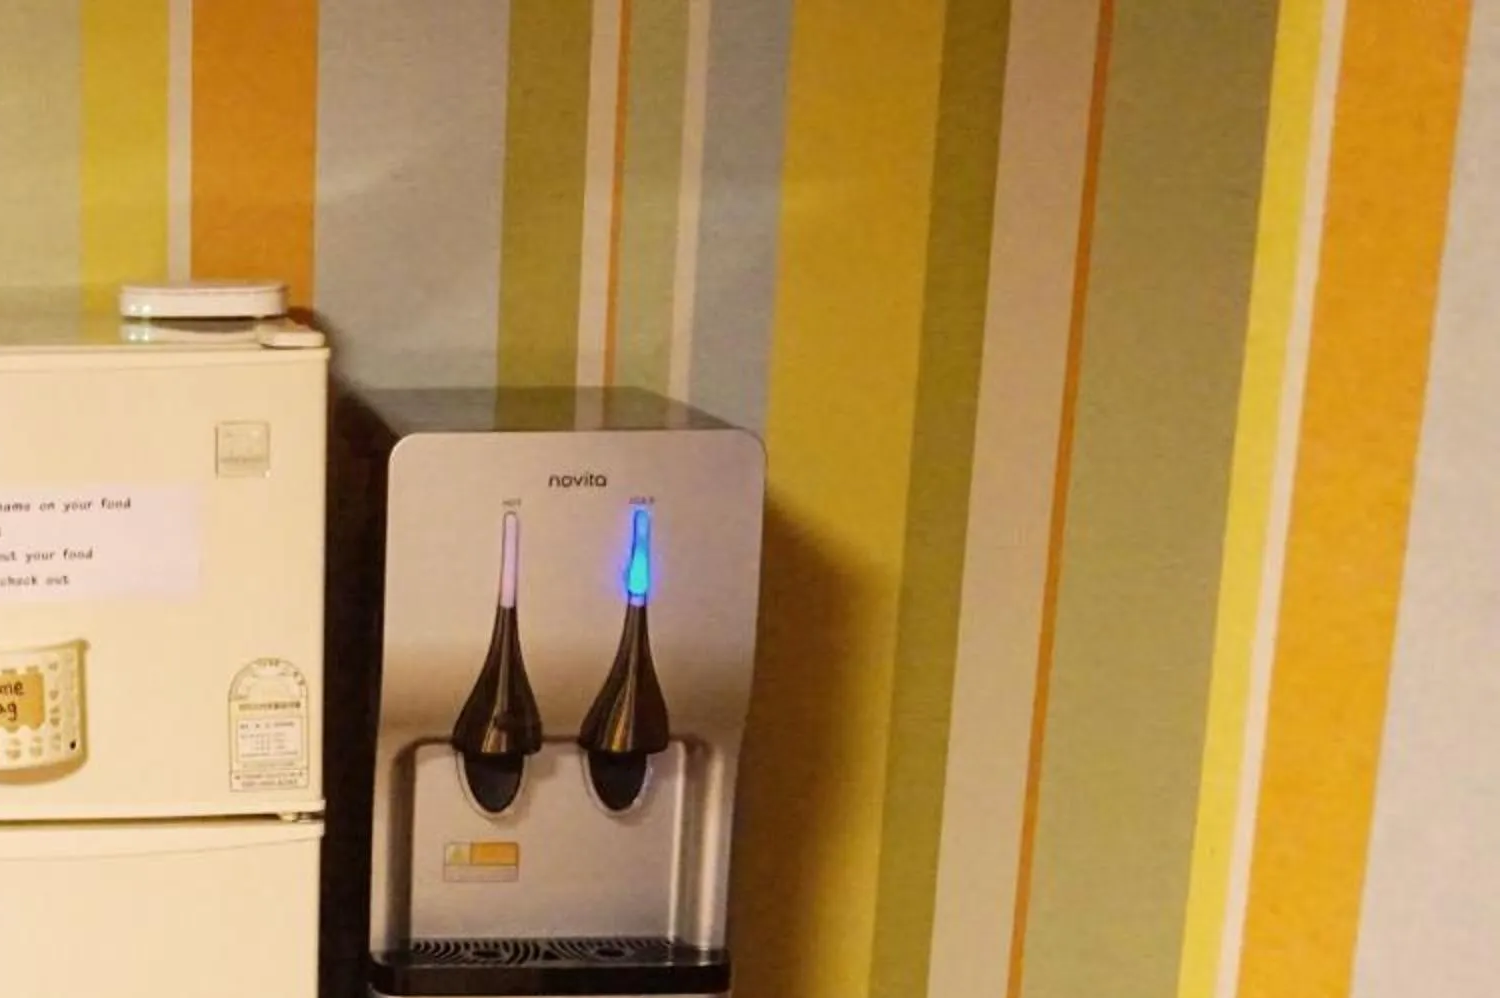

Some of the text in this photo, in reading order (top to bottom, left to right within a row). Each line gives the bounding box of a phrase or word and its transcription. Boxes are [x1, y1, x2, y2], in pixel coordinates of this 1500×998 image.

[548, 473, 608, 488] novita
[38, 501, 56, 512] on
[62, 500, 93, 514] your
[100, 497, 132, 511] food
[24, 551, 56, 564] your
[62, 546, 94, 560] food
[44, 574, 71, 586] out
